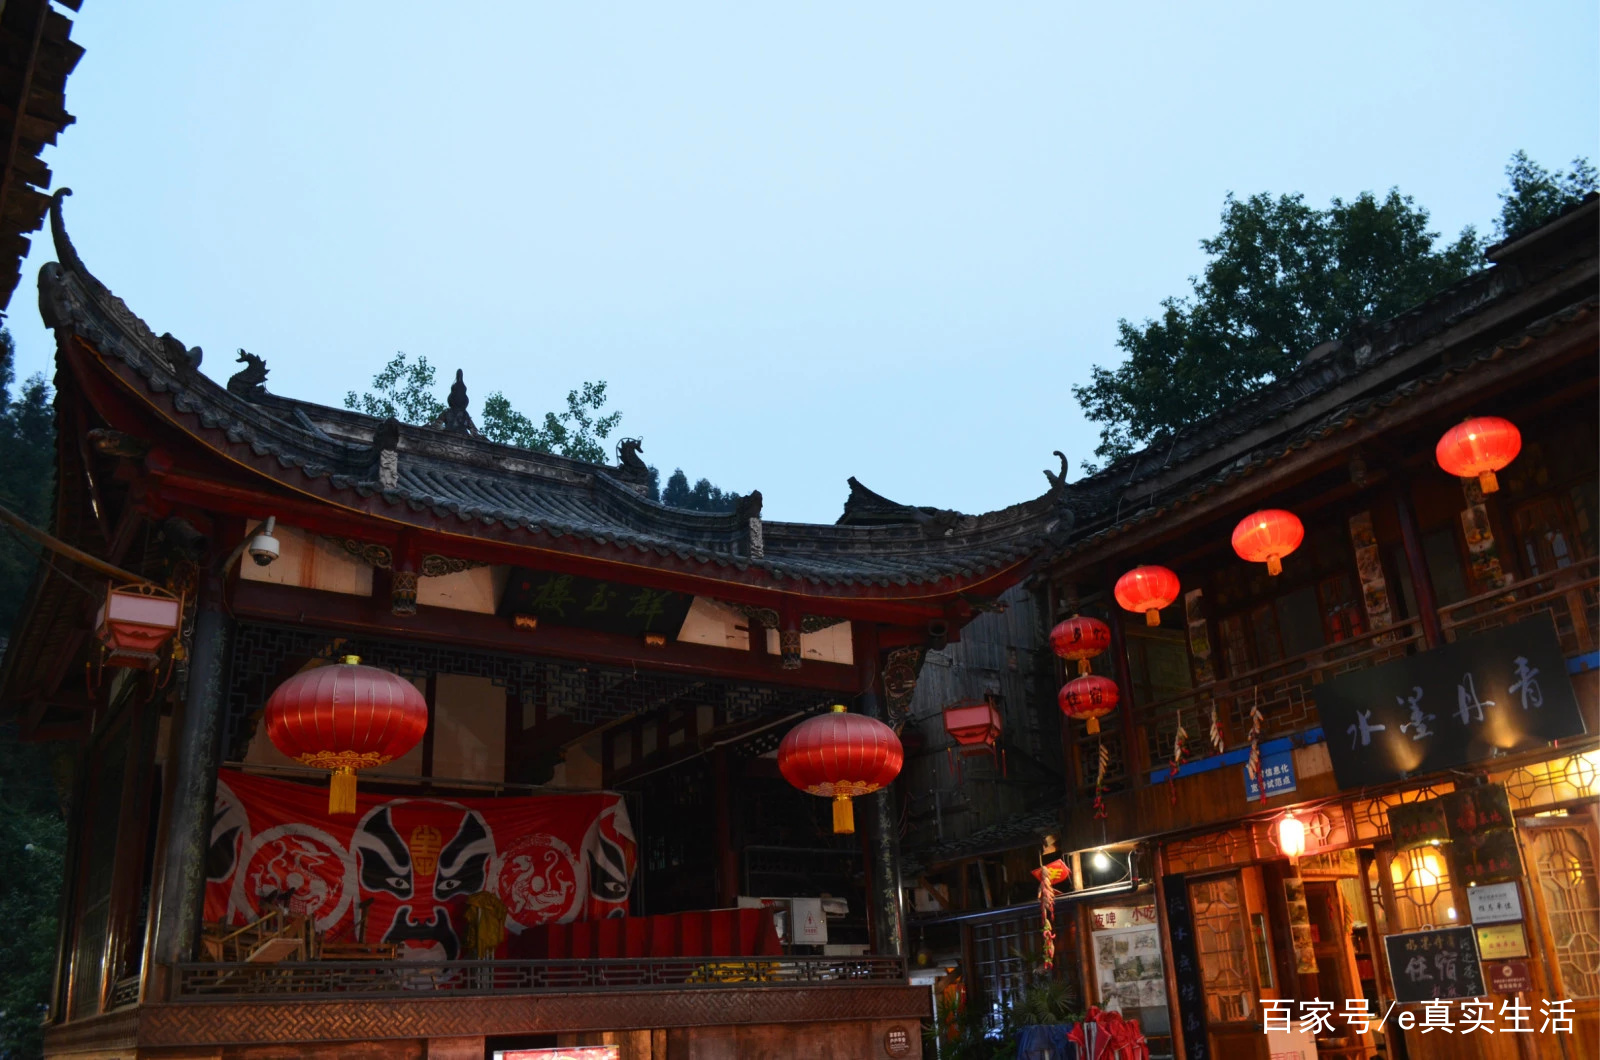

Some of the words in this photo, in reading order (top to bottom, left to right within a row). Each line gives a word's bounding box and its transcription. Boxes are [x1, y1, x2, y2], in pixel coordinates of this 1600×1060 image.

[1066, 687, 1103, 706] 住宿
[1346, 655, 1544, 750] 水墨丹青
[1132, 904, 1155, 921] 小吃
[1405, 950, 1458, 982] 住宿
